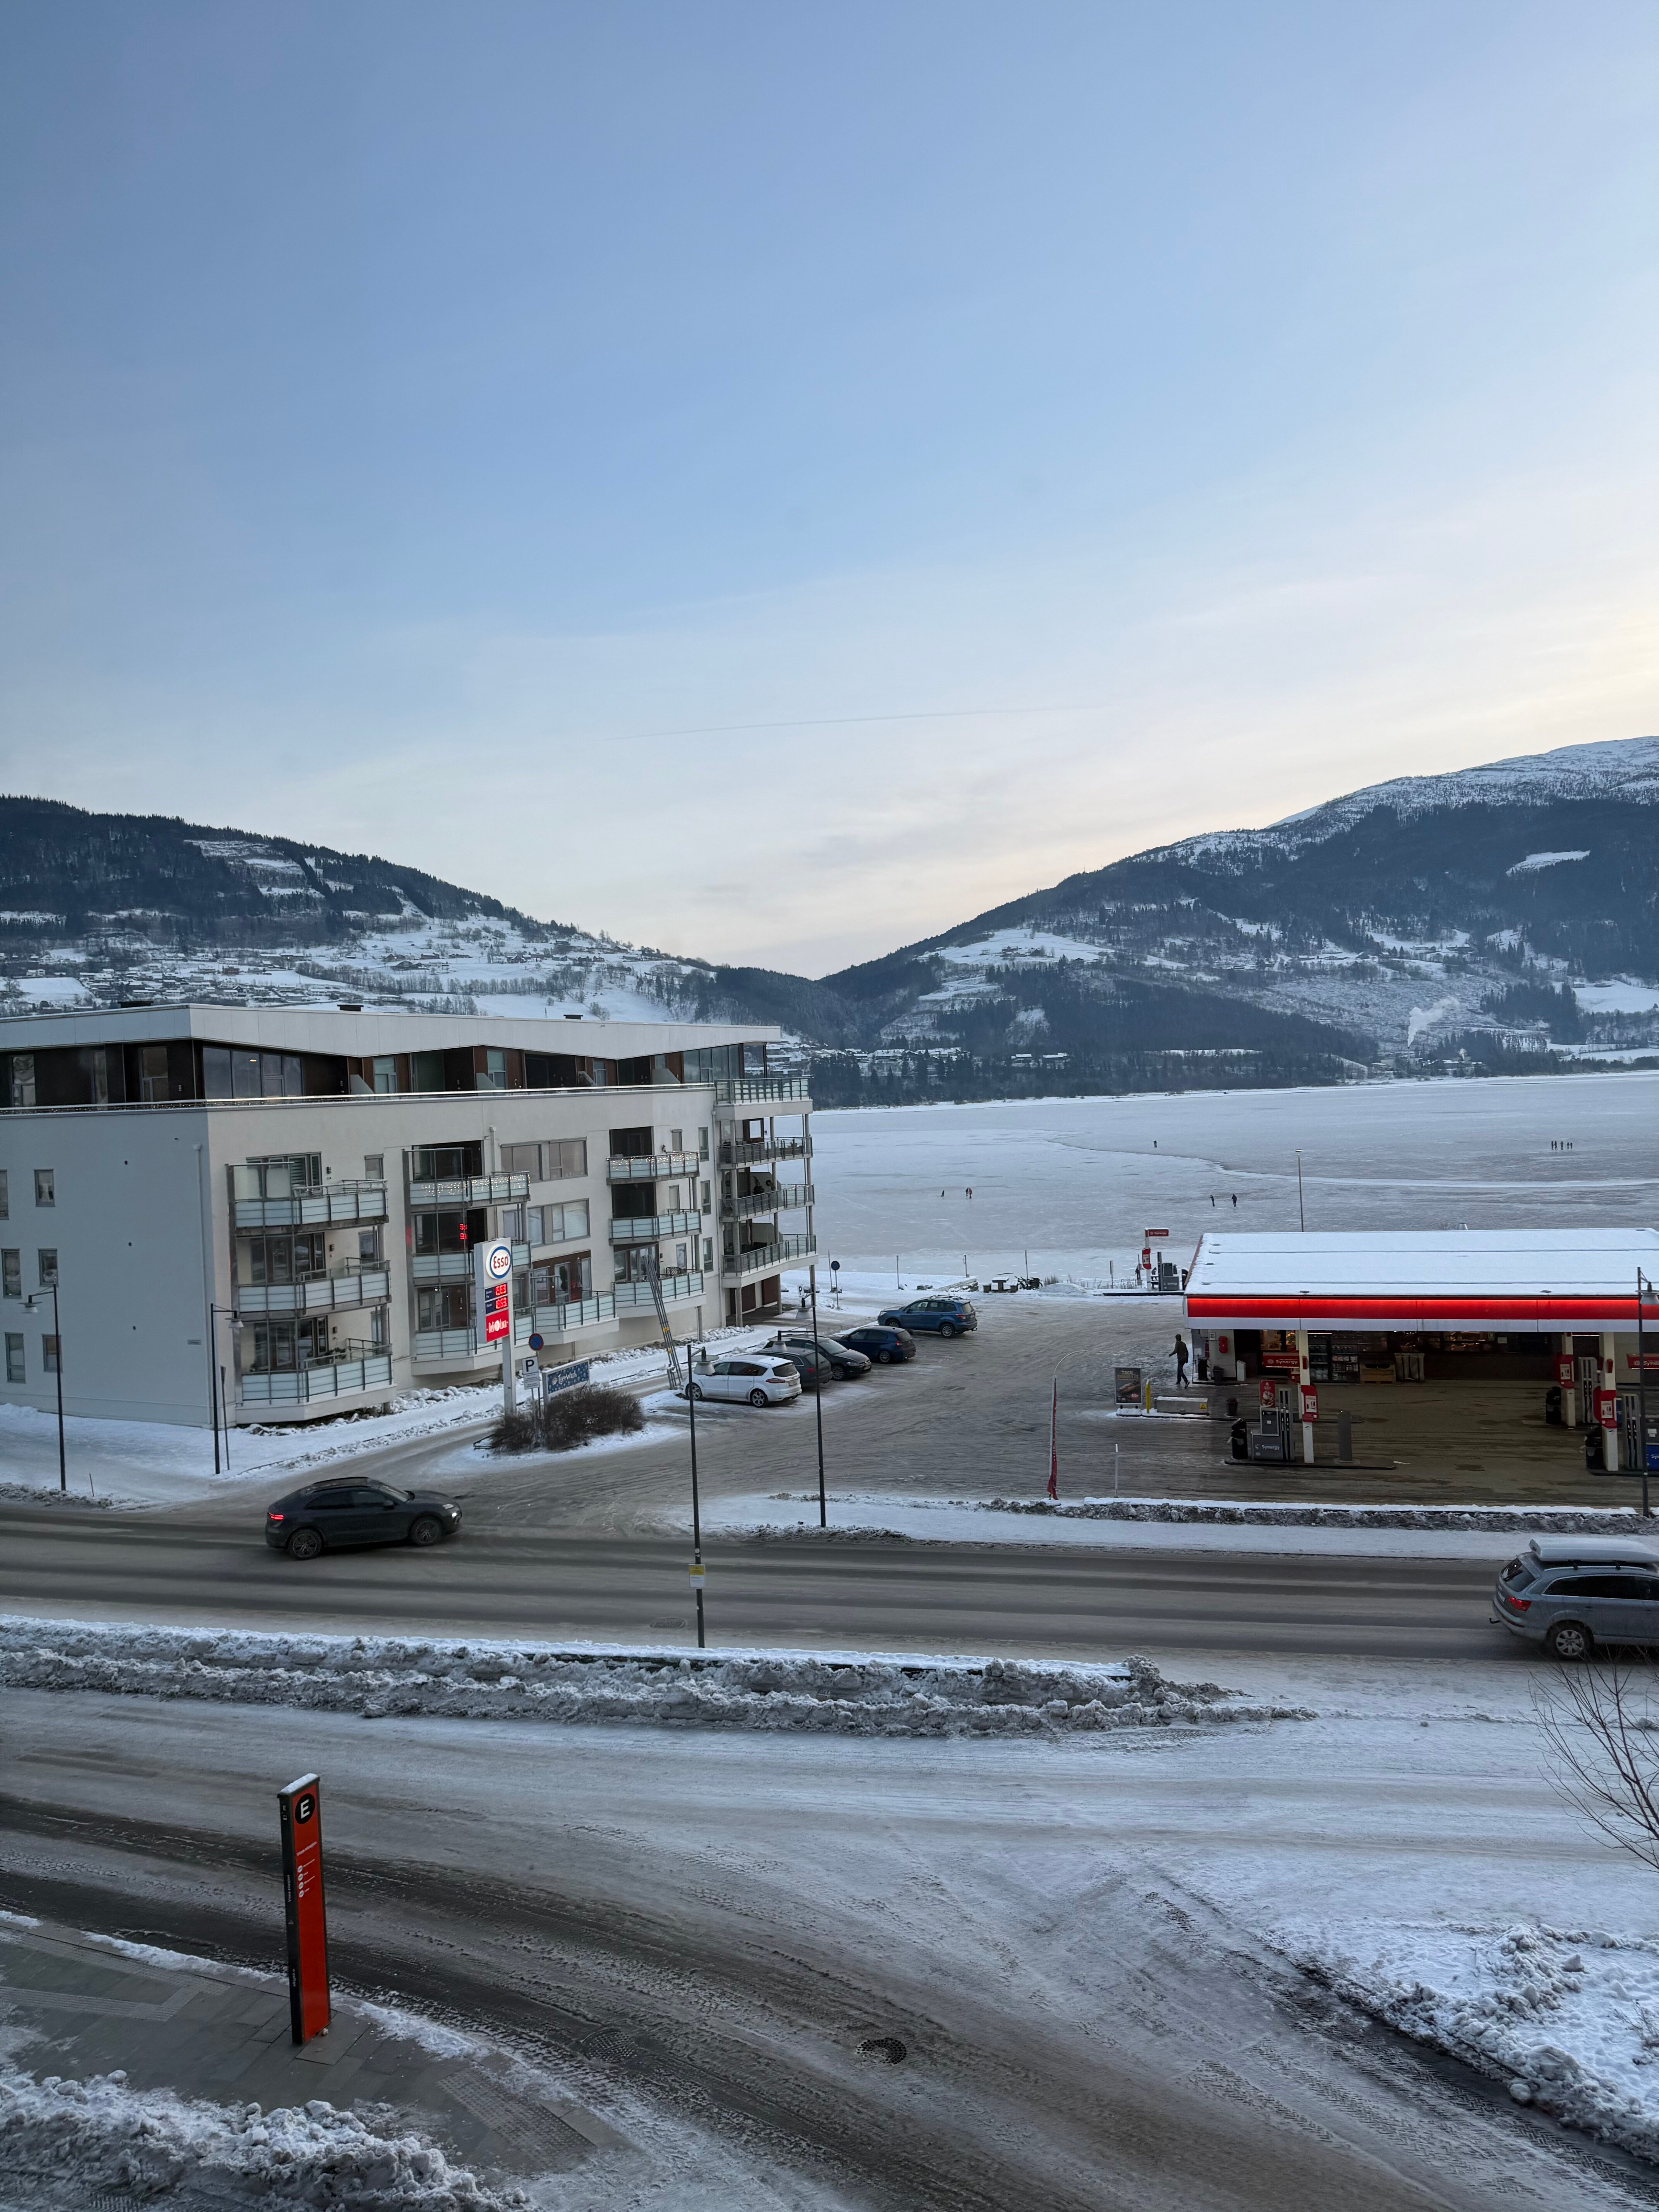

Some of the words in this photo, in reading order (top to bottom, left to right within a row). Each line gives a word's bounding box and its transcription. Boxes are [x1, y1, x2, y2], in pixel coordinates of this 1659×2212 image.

[493, 1256, 508, 1269] Esso
[799, 1286, 802, 1295] P
[526, 1359, 534, 1372] P
[301, 1799, 310, 1819] E
